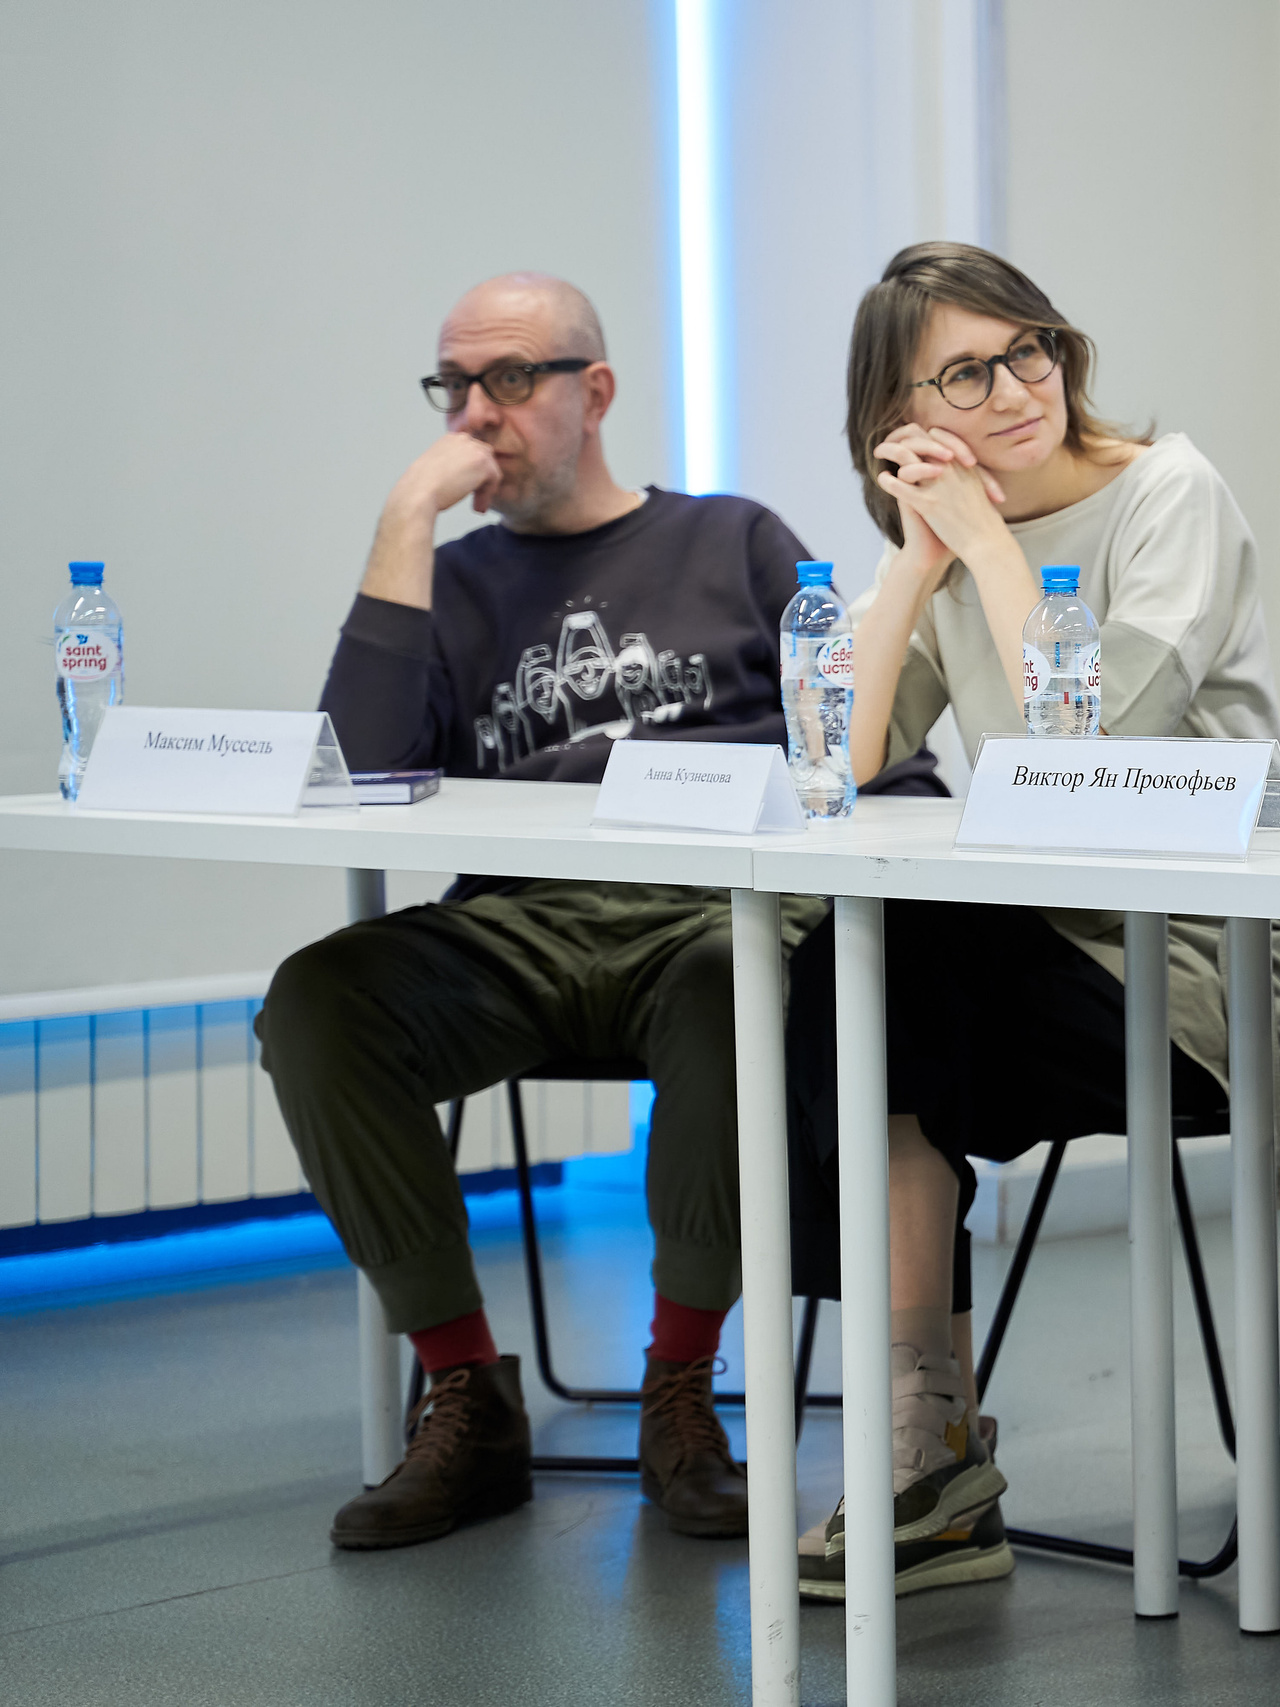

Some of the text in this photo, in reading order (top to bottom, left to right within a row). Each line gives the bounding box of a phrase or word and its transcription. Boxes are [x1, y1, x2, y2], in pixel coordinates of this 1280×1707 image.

[66, 644, 103, 656] saint
[62, 657, 107, 671] spring
[144, 731, 274, 758] Максим Муссель
[644, 767, 732, 785] Анна Кузнецова
[1012, 765, 1237, 796] Виктор Ян Прокофьев
